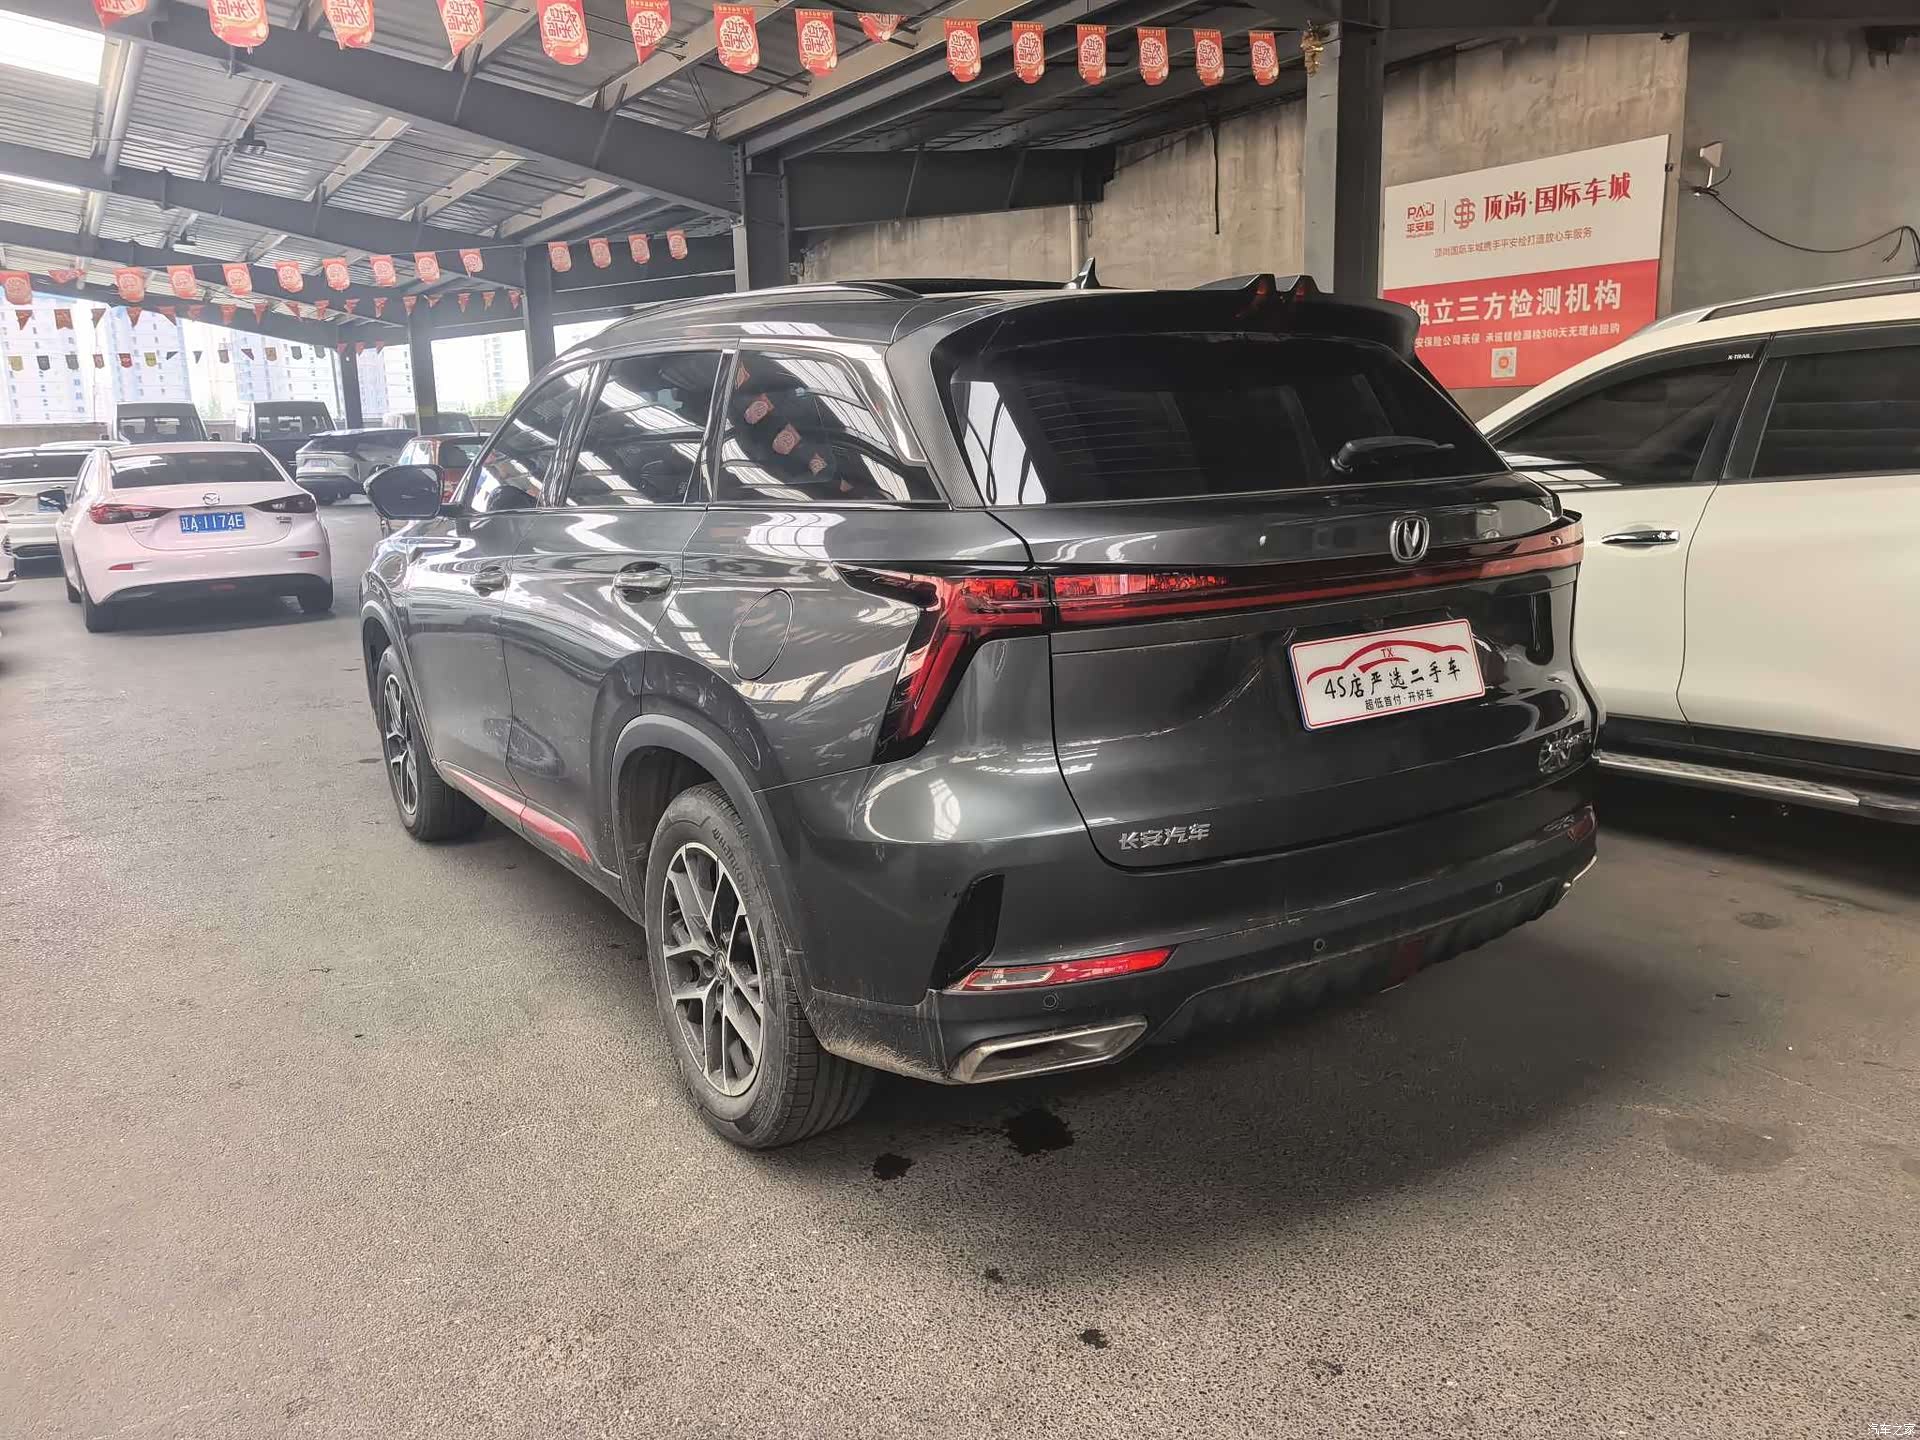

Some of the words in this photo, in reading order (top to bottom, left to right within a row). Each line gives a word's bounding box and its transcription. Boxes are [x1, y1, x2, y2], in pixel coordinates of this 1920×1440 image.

[1484, 172, 1631, 223] 顶尚·国际车城
[1410, 279, 1622, 326] 独立三方检测机构
[1381, 647, 1394, 658] TX
[1324, 657, 1461, 699] 4S店严选二手车
[1365, 687, 1435, 711] 超低首付·开好车
[1119, 823, 1211, 851] 长安汽车
